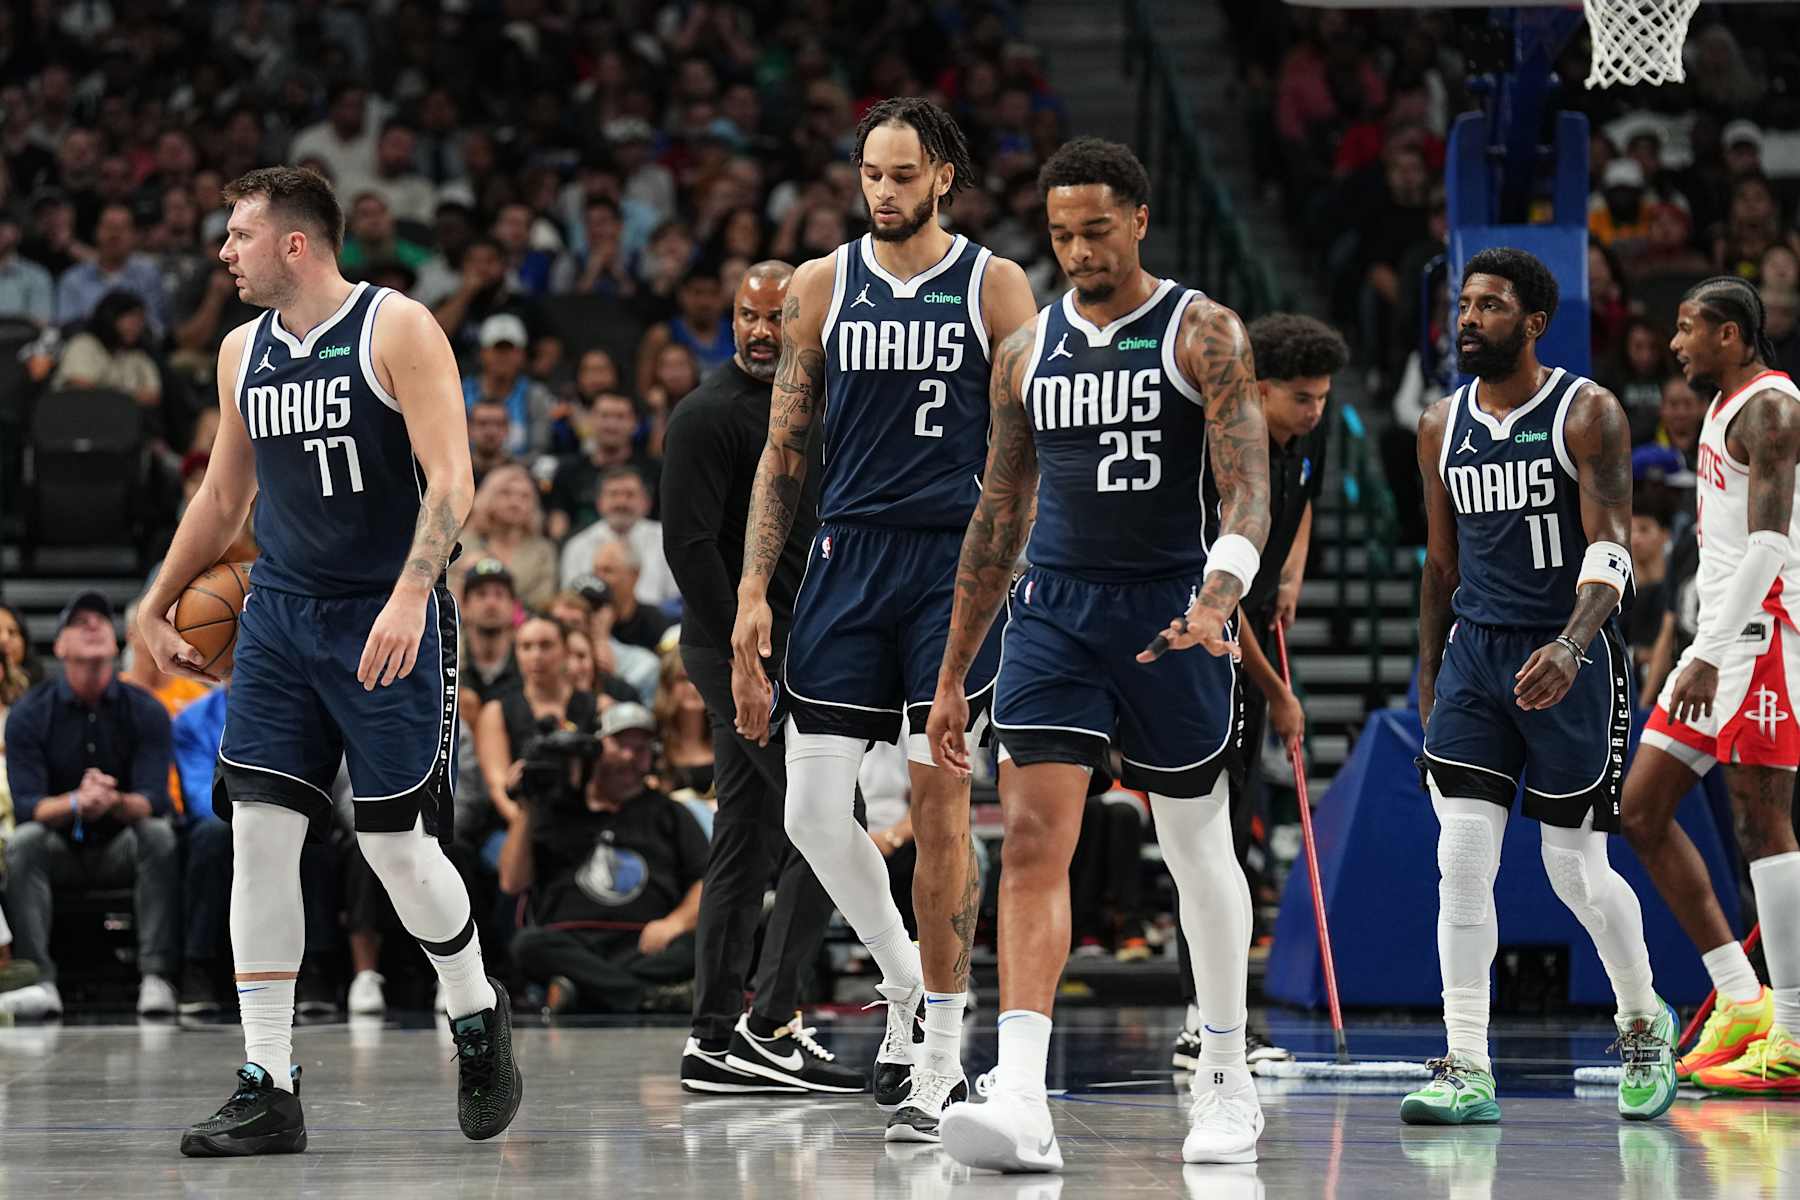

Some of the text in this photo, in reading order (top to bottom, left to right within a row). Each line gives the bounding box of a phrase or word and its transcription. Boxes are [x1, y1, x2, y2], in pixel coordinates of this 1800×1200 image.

[923, 291, 962, 305] chime
[318, 345, 351, 360] chime
[838, 320, 966, 373] MAVS
[1117, 336, 1158, 351] chime
[247, 375, 351, 440] MAVS
[914, 378, 947, 438] 2
[1032, 368, 1161, 431] MAVS
[303, 435, 364, 497] 77
[1096, 430, 1162, 492] 25
[1514, 430, 1548, 444] chime
[1447, 457, 1556, 515] MAVS
[1524, 512, 1564, 570] 11
